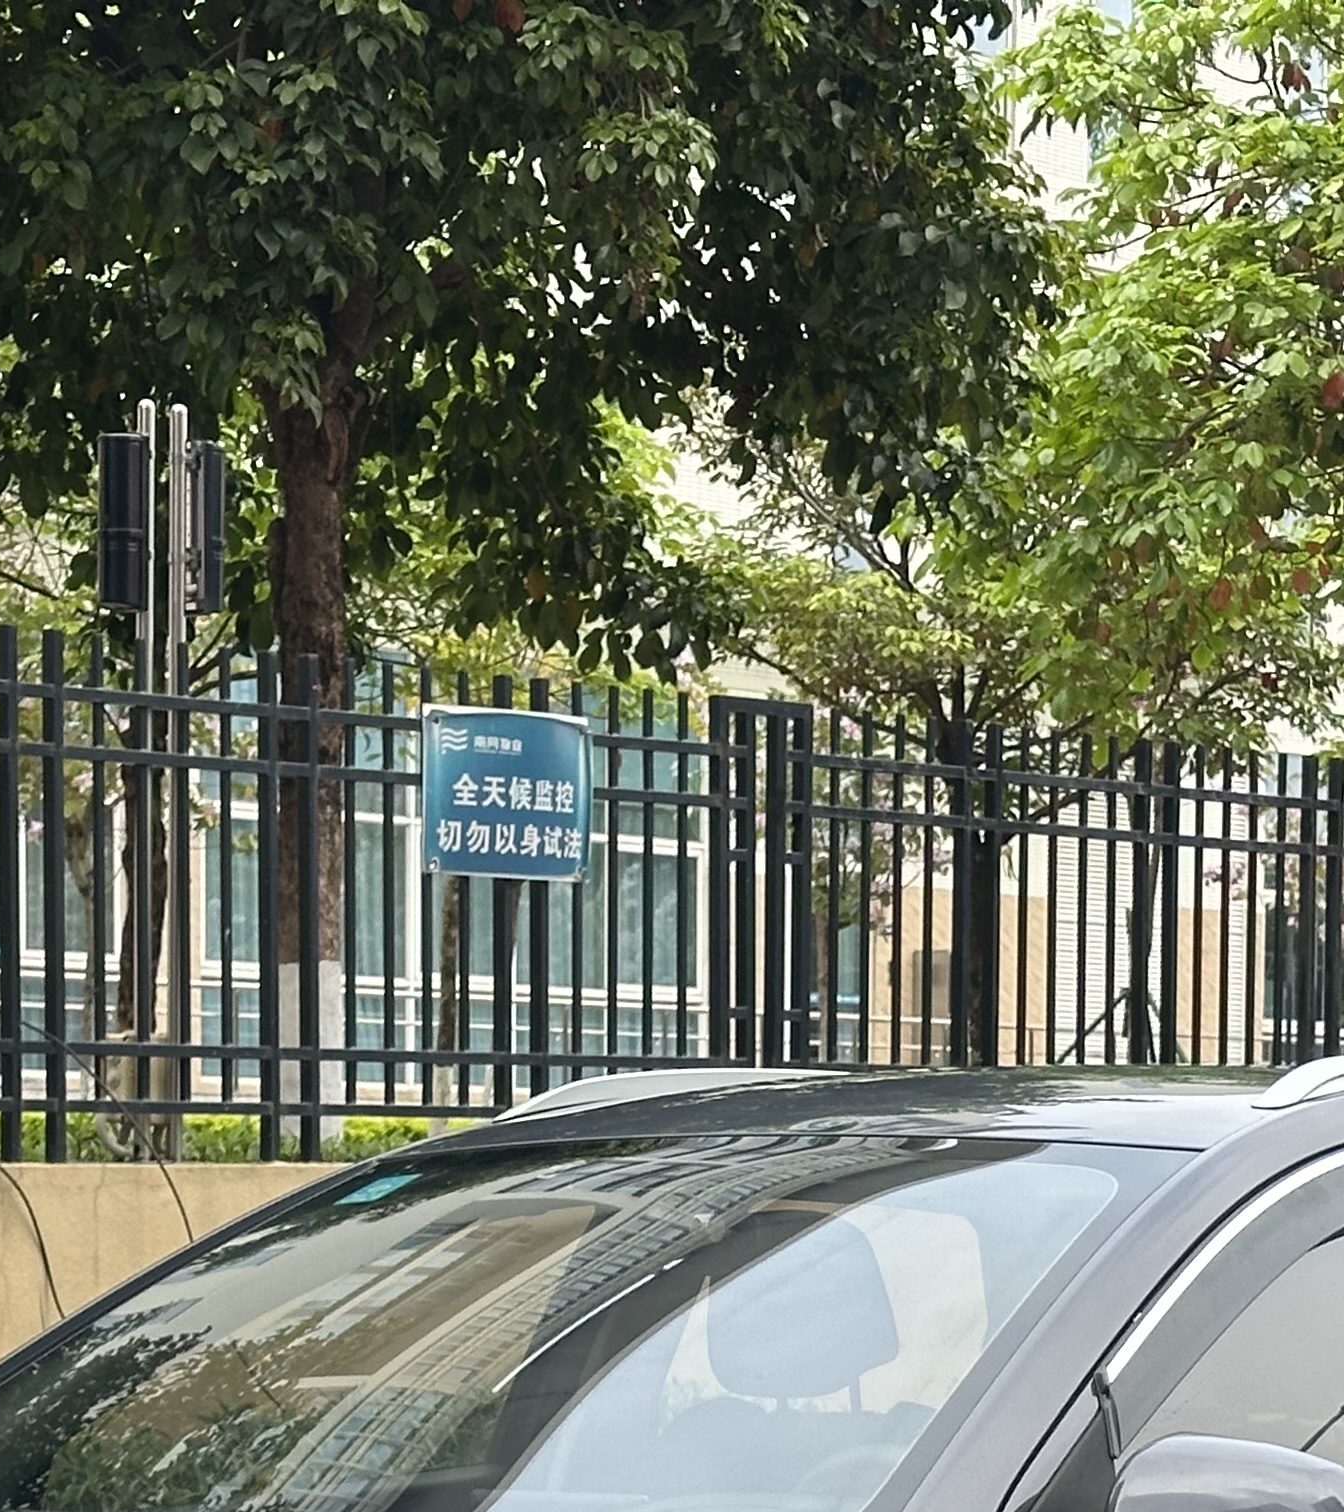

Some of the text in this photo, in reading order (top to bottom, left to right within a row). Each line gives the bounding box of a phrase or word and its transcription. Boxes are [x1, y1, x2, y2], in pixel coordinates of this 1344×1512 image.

[452, 773, 575, 814] 全天候监控
[436, 819, 583, 859] 切勿以身试法
